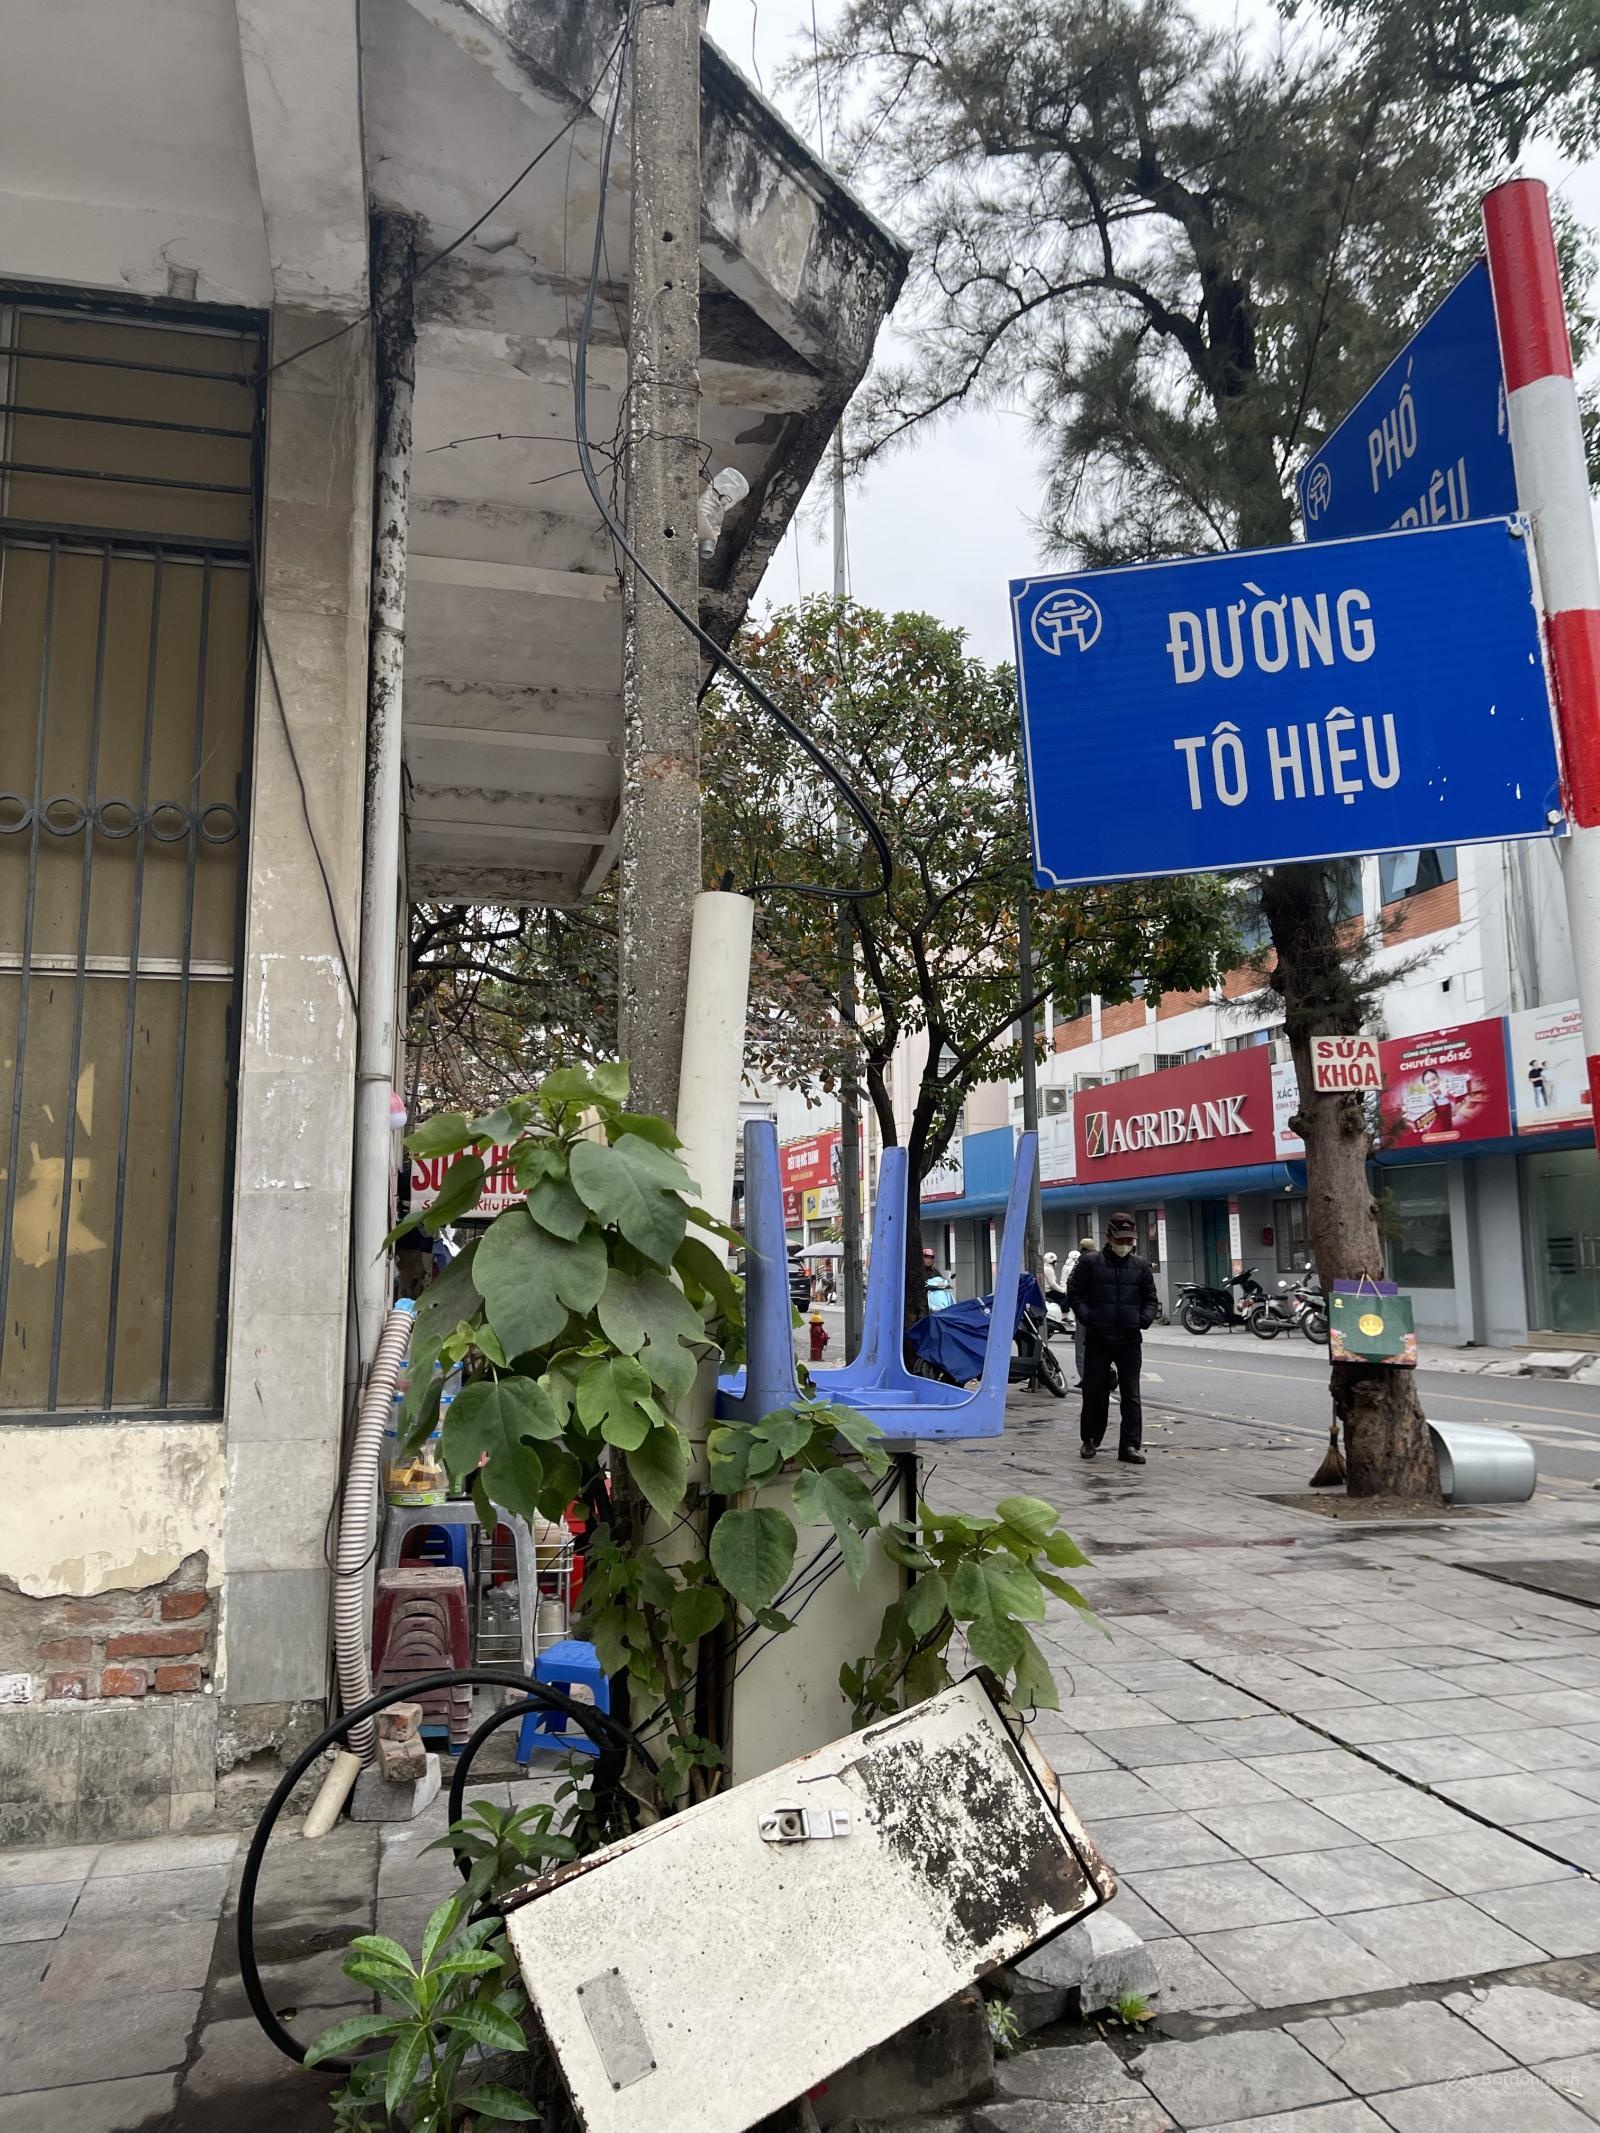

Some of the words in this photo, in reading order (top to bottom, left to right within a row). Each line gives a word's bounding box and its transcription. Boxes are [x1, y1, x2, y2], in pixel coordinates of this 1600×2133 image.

[1368, 355, 1418, 494] PHỐ
[1166, 581, 1376, 684] ĐƯỜNG
[1174, 720, 1249, 810] TÔ
[1267, 706, 1401, 805] HIỆU
[1317, 1036, 1376, 1059] SỬA
[1317, 1058, 1379, 1088] KHÓA
[1277, 1087, 1293, 1099] XÁC
[1110, 1094, 1254, 1154] AGRIBANK
